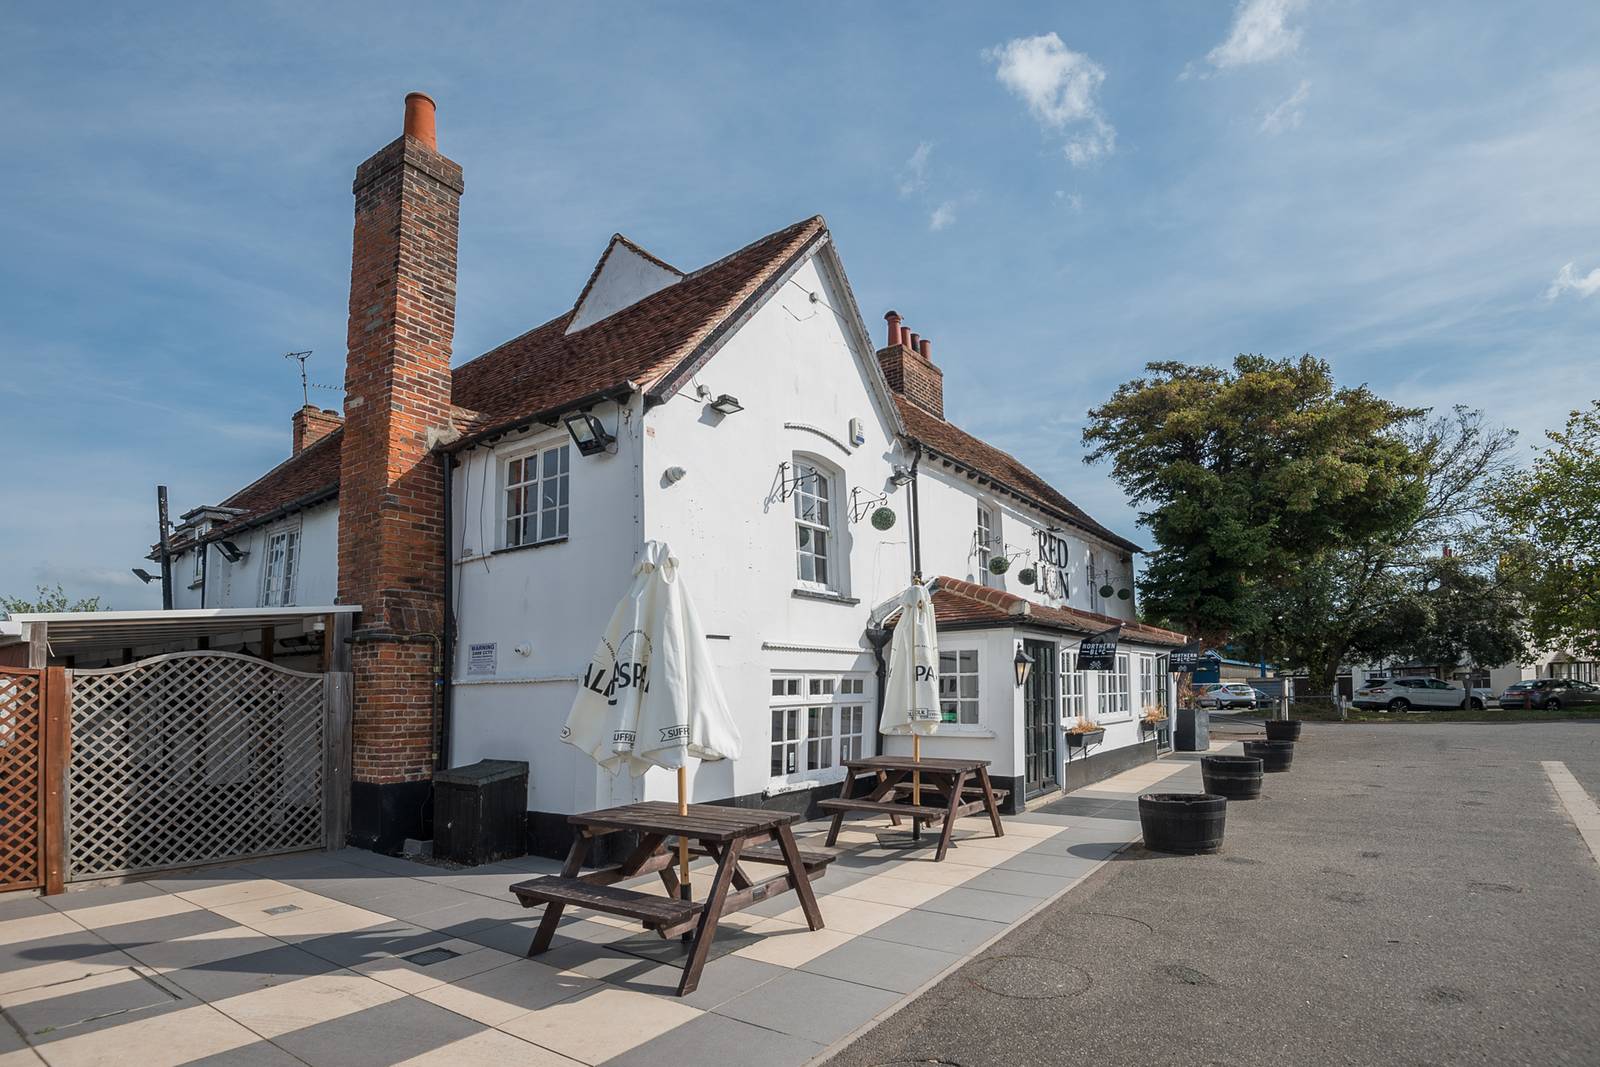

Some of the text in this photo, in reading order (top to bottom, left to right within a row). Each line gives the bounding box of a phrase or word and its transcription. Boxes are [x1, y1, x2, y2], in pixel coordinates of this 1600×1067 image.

[1038, 529, 1069, 569] RED
[1032, 561, 1070, 600] LION
[1081, 642, 1116, 650] NORTHERN
